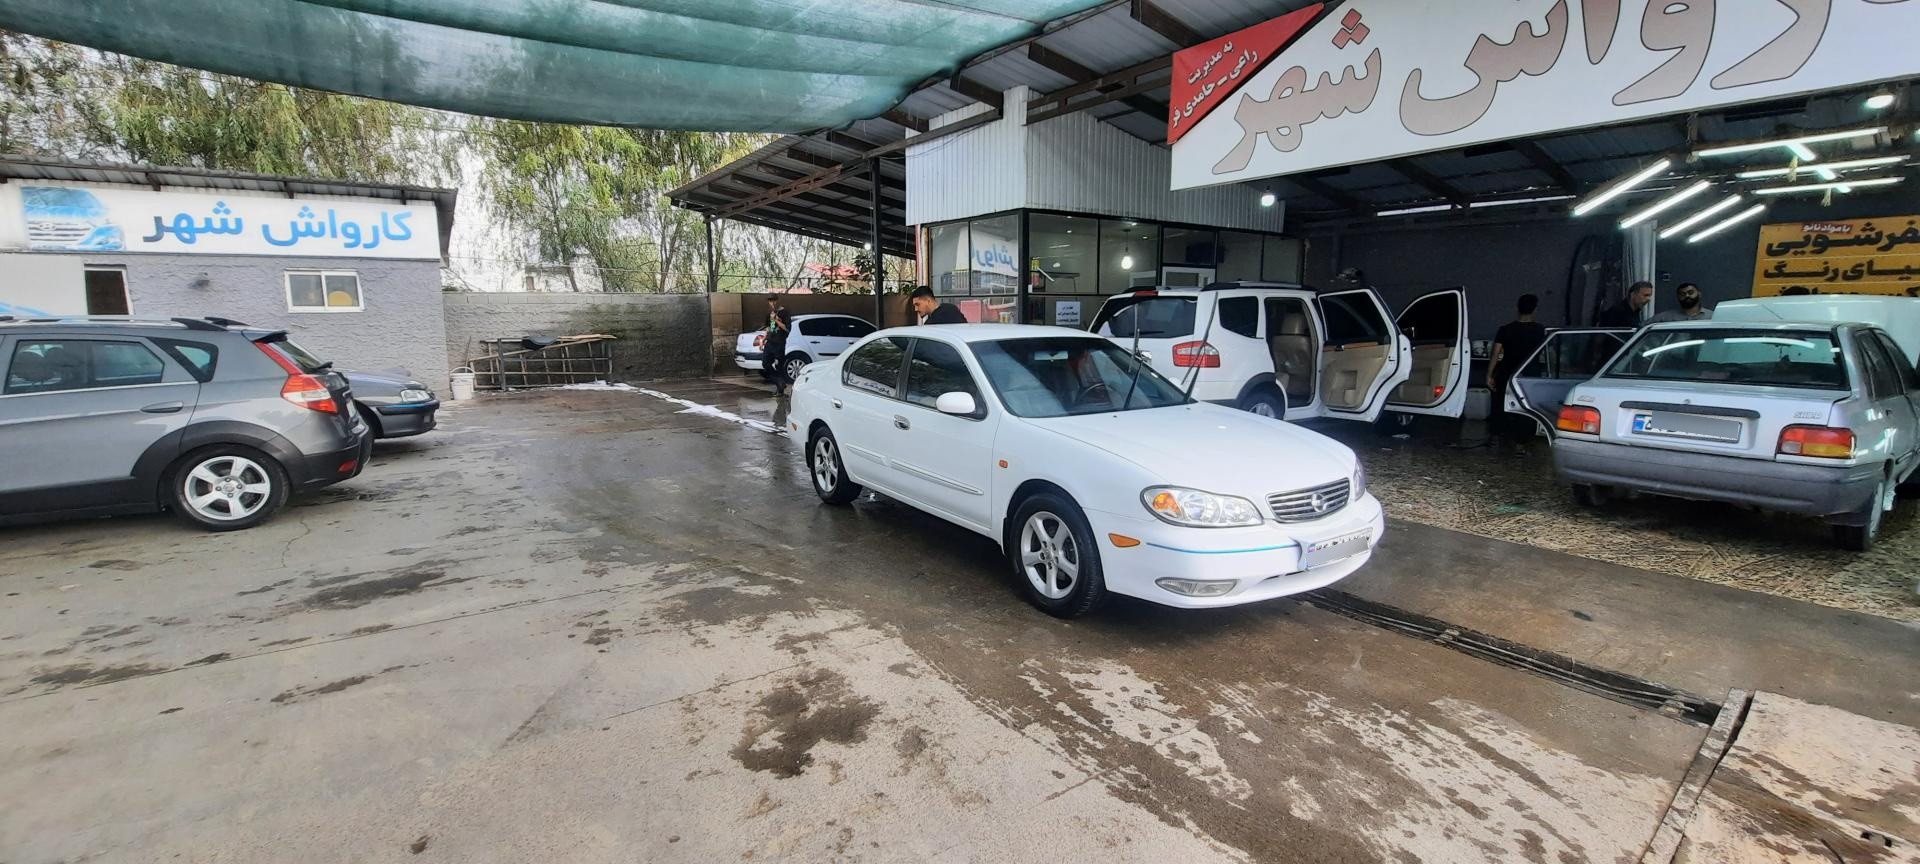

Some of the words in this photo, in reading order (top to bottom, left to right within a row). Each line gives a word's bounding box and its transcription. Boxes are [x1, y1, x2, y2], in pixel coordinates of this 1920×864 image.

[1223, 41, 1234, 53] به
[1229, 48, 1259, 79] راعی
[1188, 51, 1223, 84] مدیریت
[1183, 82, 1216, 118] حامدی
[1212, 8, 1382, 174] شهر
[1172, 106, 1181, 128] فر
[142, 201, 244, 244] شهر
[261, 205, 413, 249] کارواش
[1763, 261, 1839, 282] رنگ
